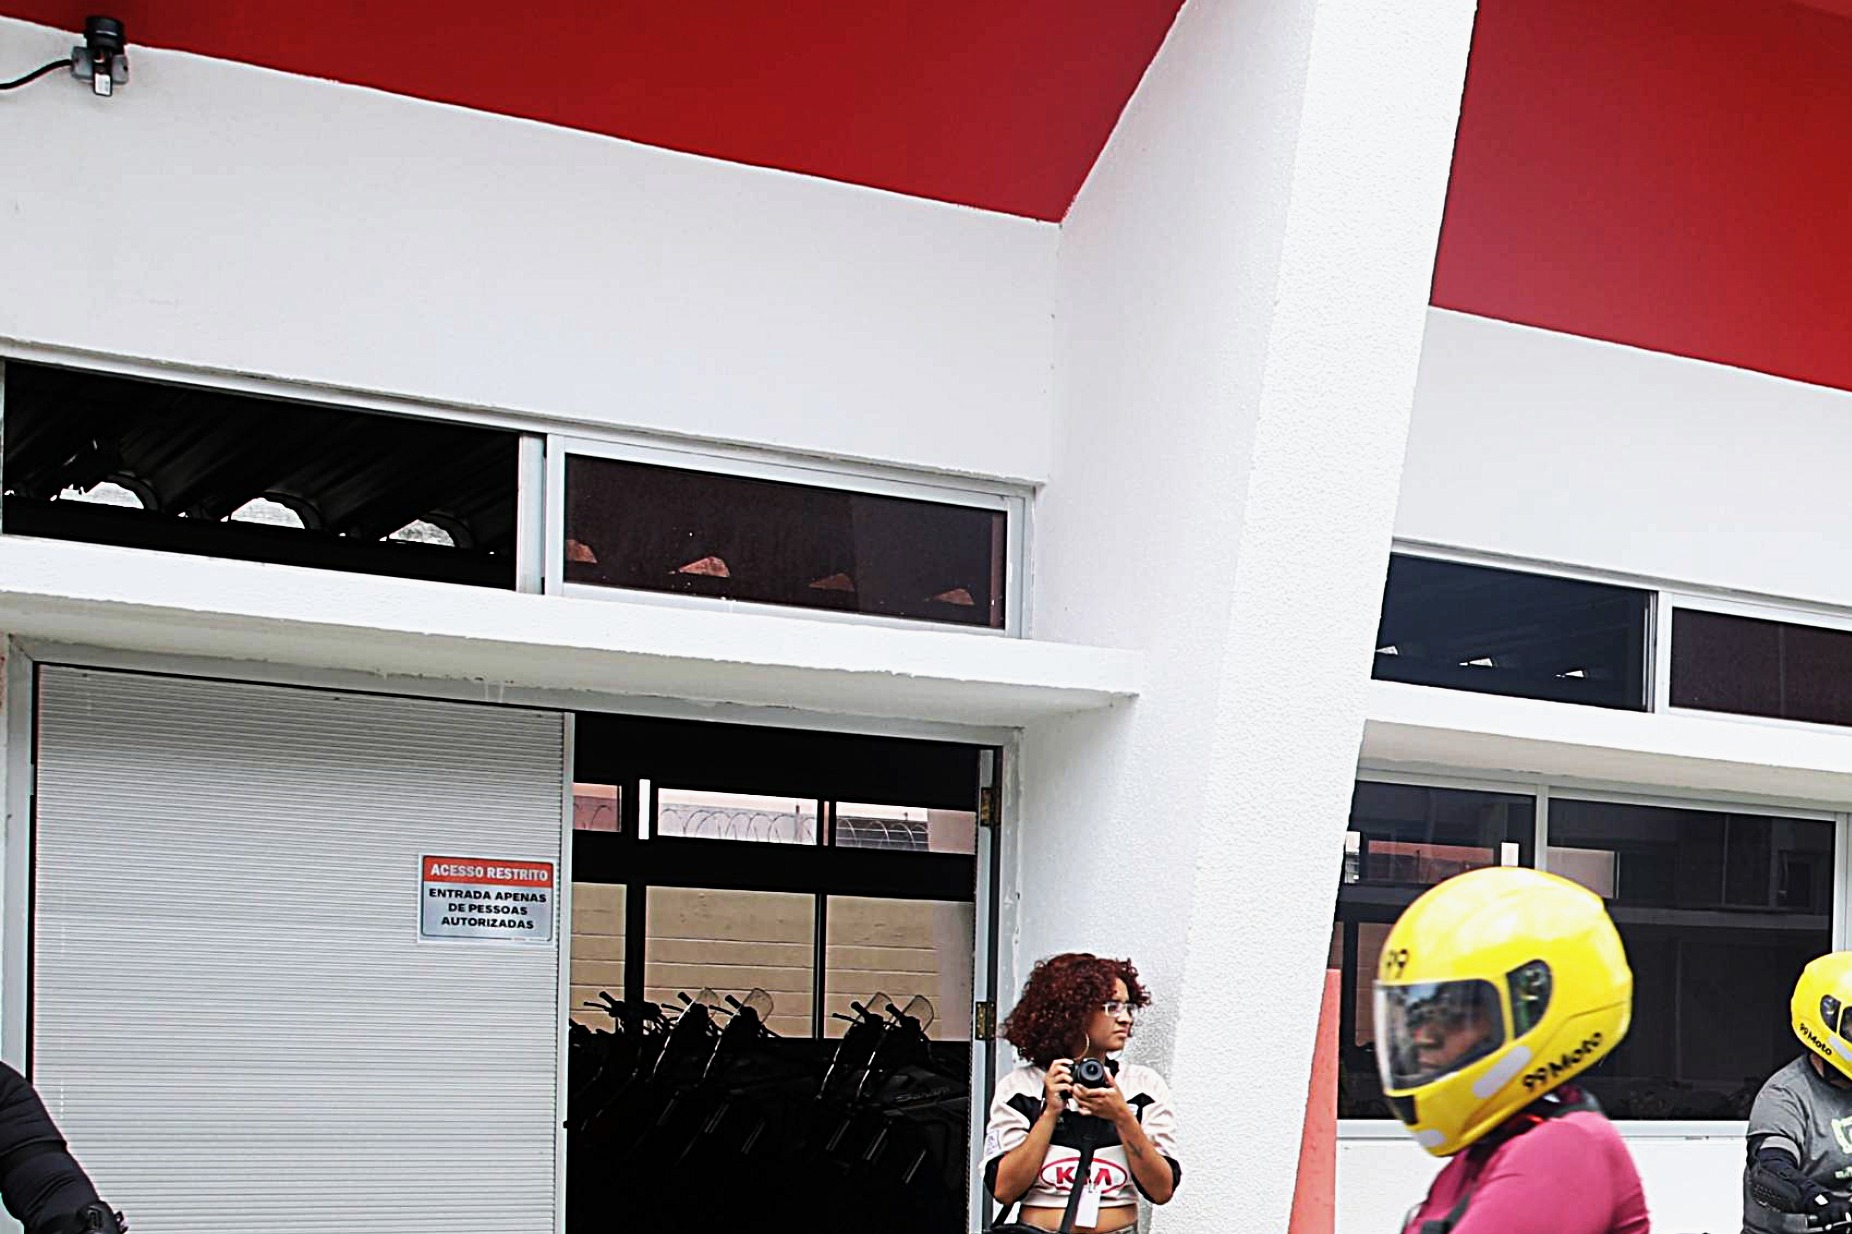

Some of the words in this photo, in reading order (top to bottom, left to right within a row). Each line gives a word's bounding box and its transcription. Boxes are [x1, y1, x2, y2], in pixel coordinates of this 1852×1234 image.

[430, 863, 484, 876] ACESSO
[486, 867, 548, 881] RESTRITO
[428, 888, 491, 900] ENTRADA
[494, 891, 547, 903] APENAS
[448, 903, 466, 912] DE
[468, 903, 528, 915] PESSOAS
[441, 916, 534, 929] AUTORIZADAS
[1055, 1166, 1112, 1186] KA
